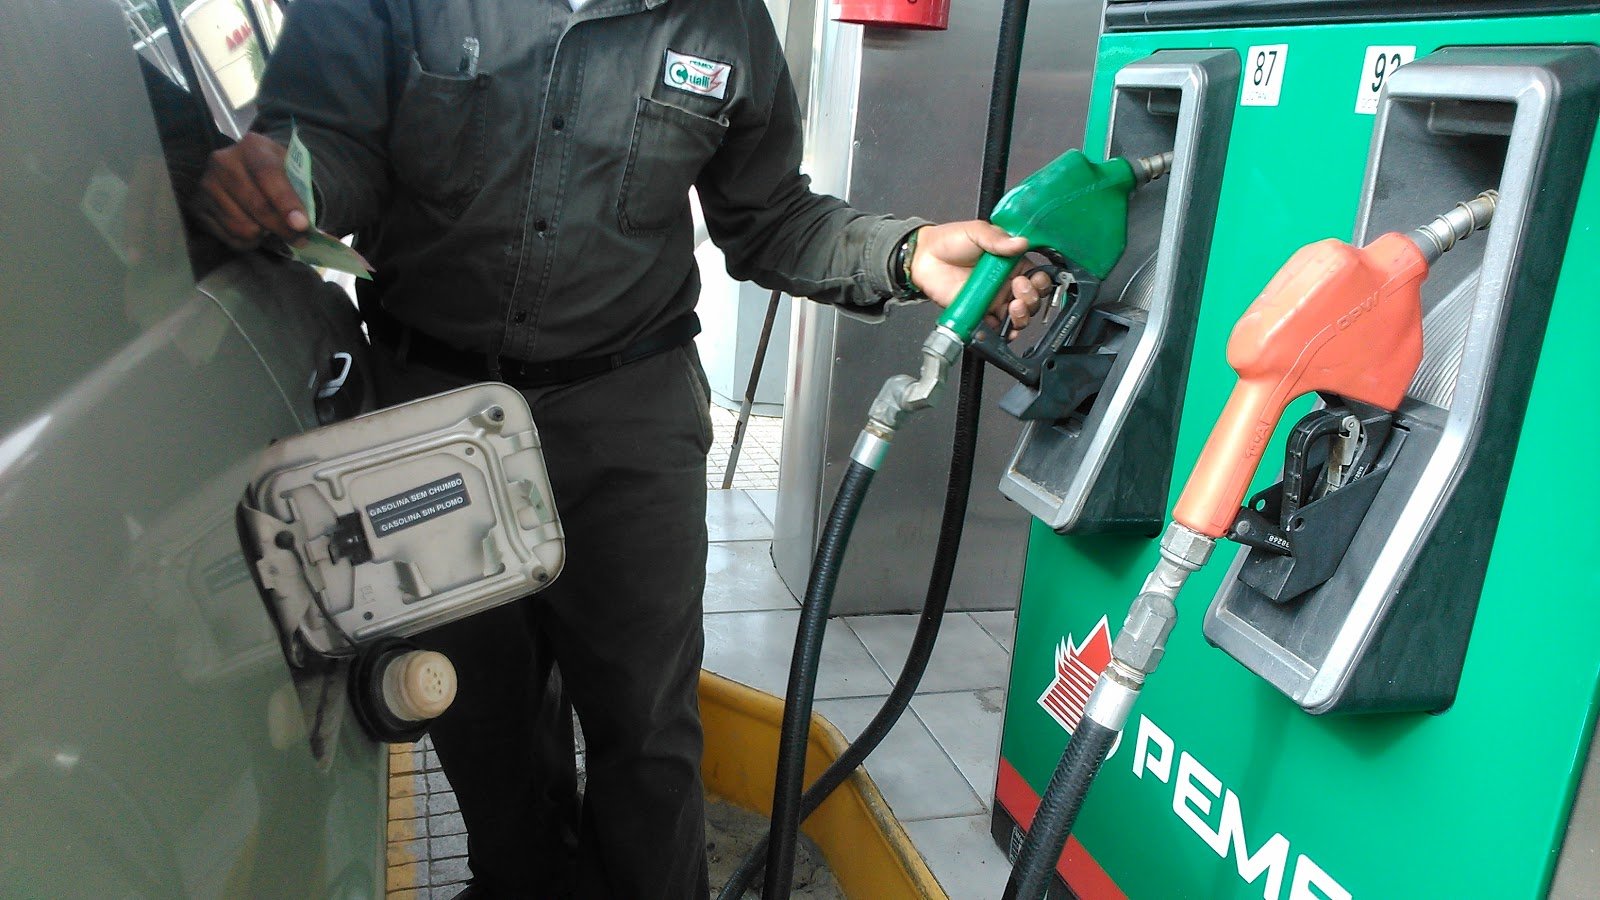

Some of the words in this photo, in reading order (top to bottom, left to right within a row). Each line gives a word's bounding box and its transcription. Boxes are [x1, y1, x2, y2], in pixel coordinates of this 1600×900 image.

[1253, 51, 1277, 86] 87
[369, 497, 410, 517] GASOLINA
[410, 490, 428, 503] SEM
[428, 478, 463, 496] CHUMBO
[381, 512, 422, 532] GASOLINA
[422, 507, 436, 517] SIN
[436, 496, 464, 511] PLOMO
